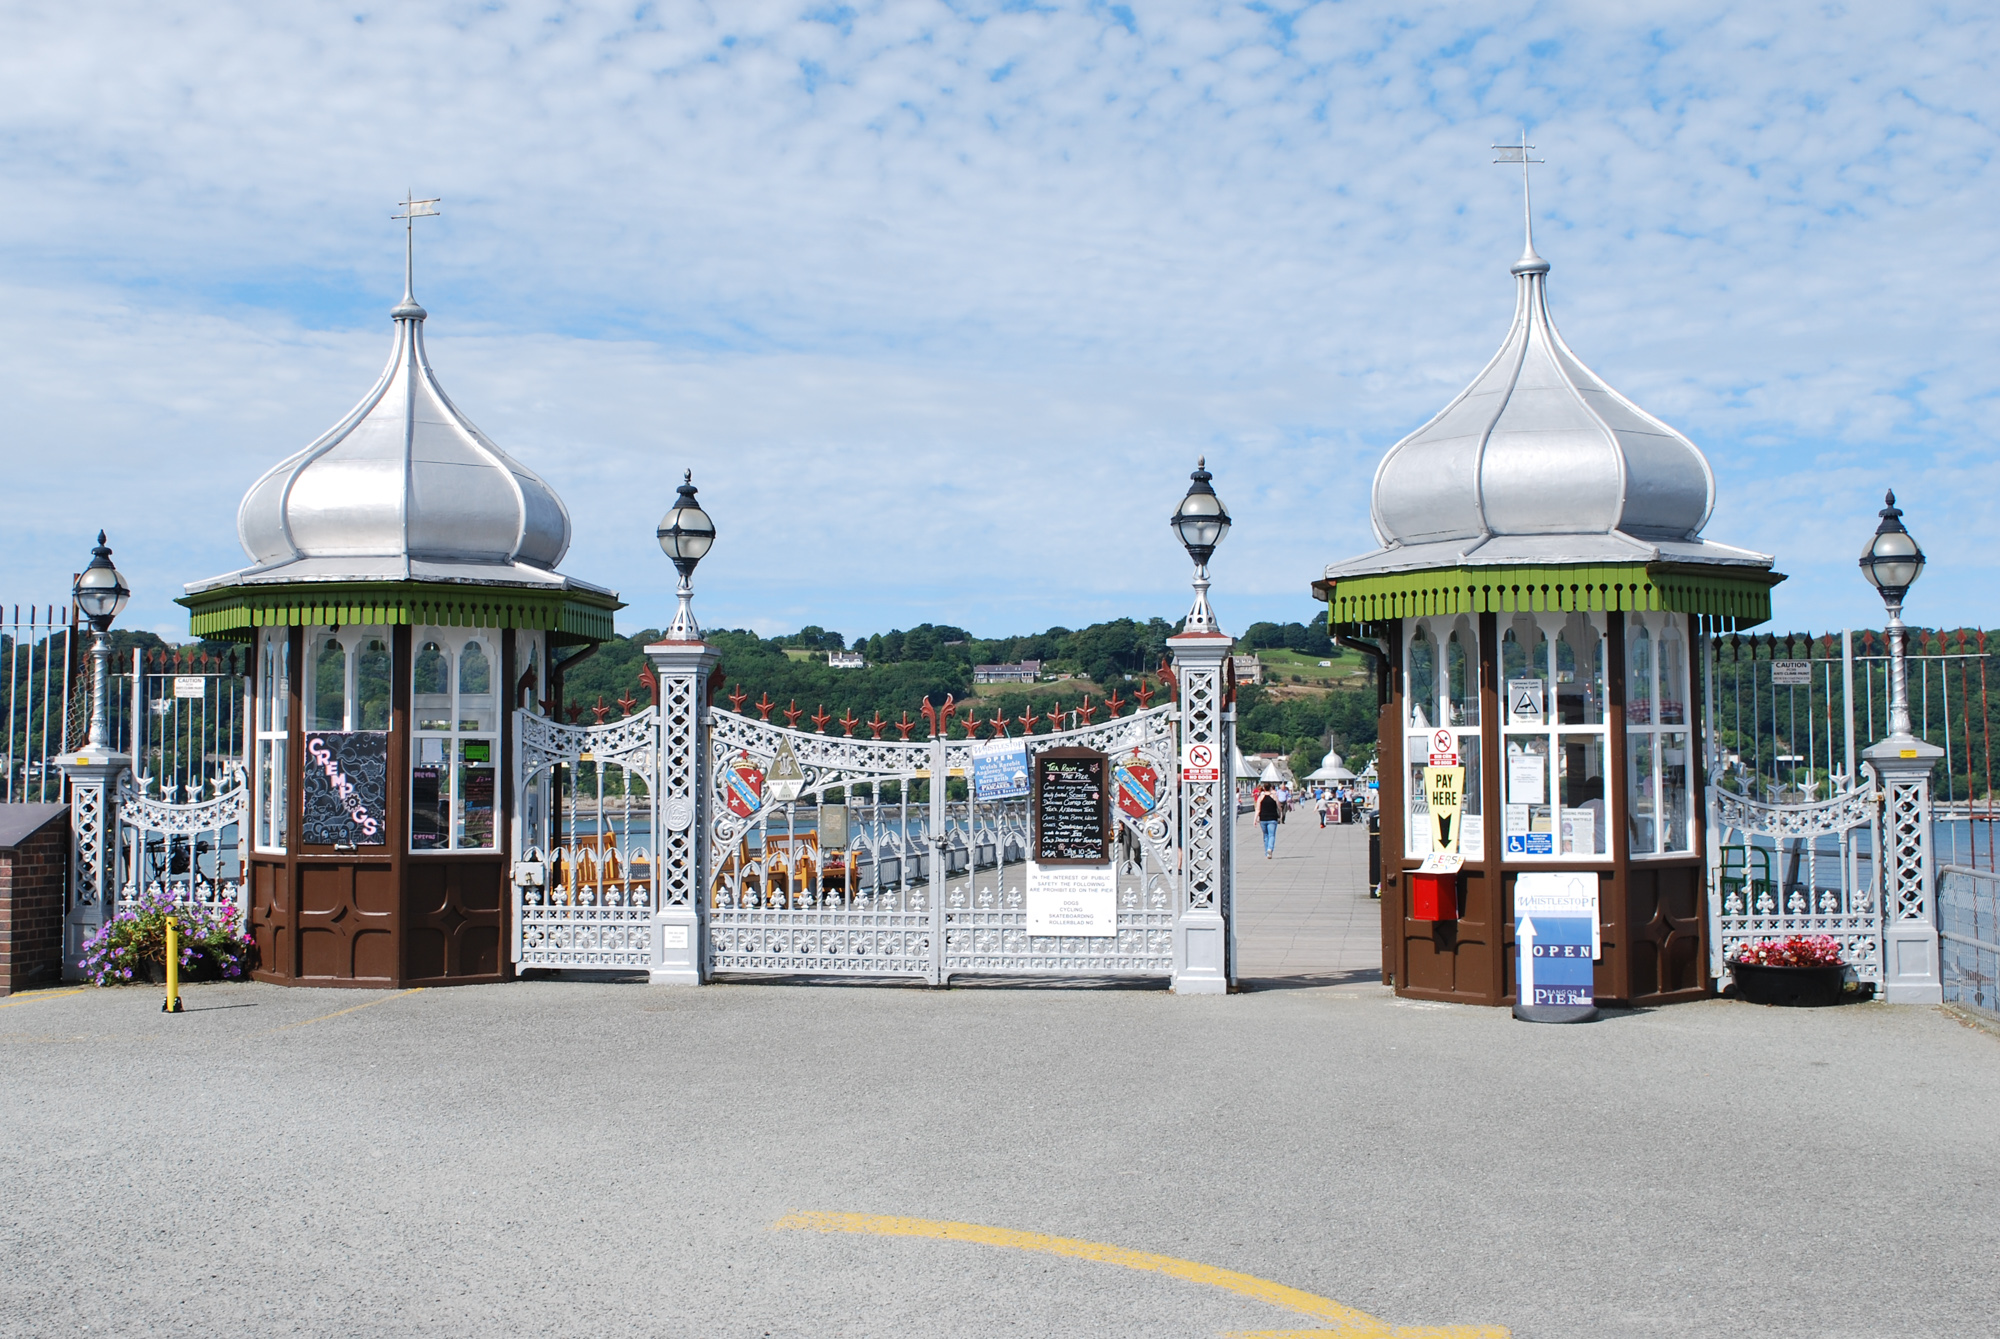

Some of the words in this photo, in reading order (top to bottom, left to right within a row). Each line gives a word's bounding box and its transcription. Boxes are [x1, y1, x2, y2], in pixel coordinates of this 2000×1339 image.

[973, 741, 1023, 754] WHISTLESTOP
[985, 754, 1013, 763] OPEN
[979, 763, 998, 771] Welsh
[1436, 774, 1453, 788] PAY
[1432, 791, 1457, 806] HERE
[1427, 853, 1462, 865] PLEASE
[1518, 895, 1589, 907] WHISTLESTOP
[1533, 945, 1590, 957] OPEN
[1534, 989, 1579, 1005] PIER
